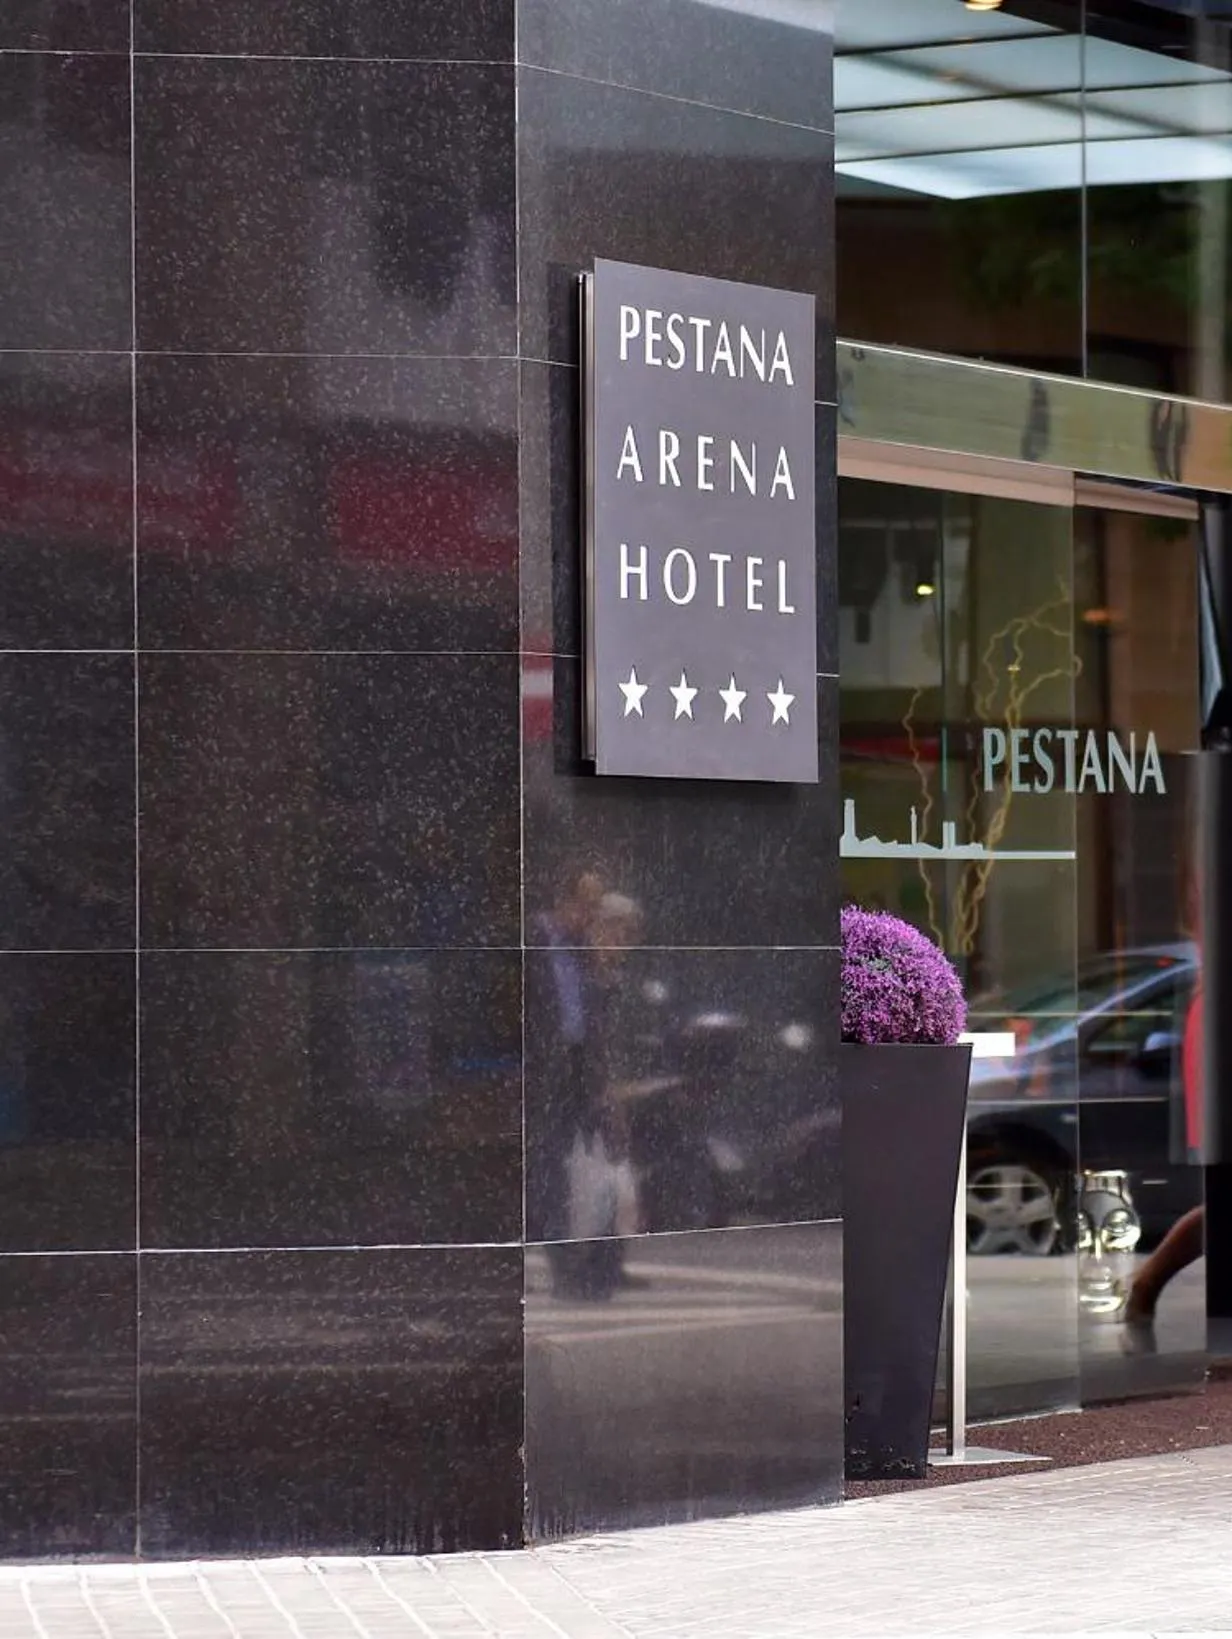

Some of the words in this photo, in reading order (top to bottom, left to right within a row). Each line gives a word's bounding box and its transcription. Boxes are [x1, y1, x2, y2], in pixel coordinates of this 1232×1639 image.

[619, 304, 795, 386] PESTANA
[616, 425, 796, 500] ARENA
[619, 543, 796, 614] HOTEL
[982, 727, 1167, 795] PESTANA
